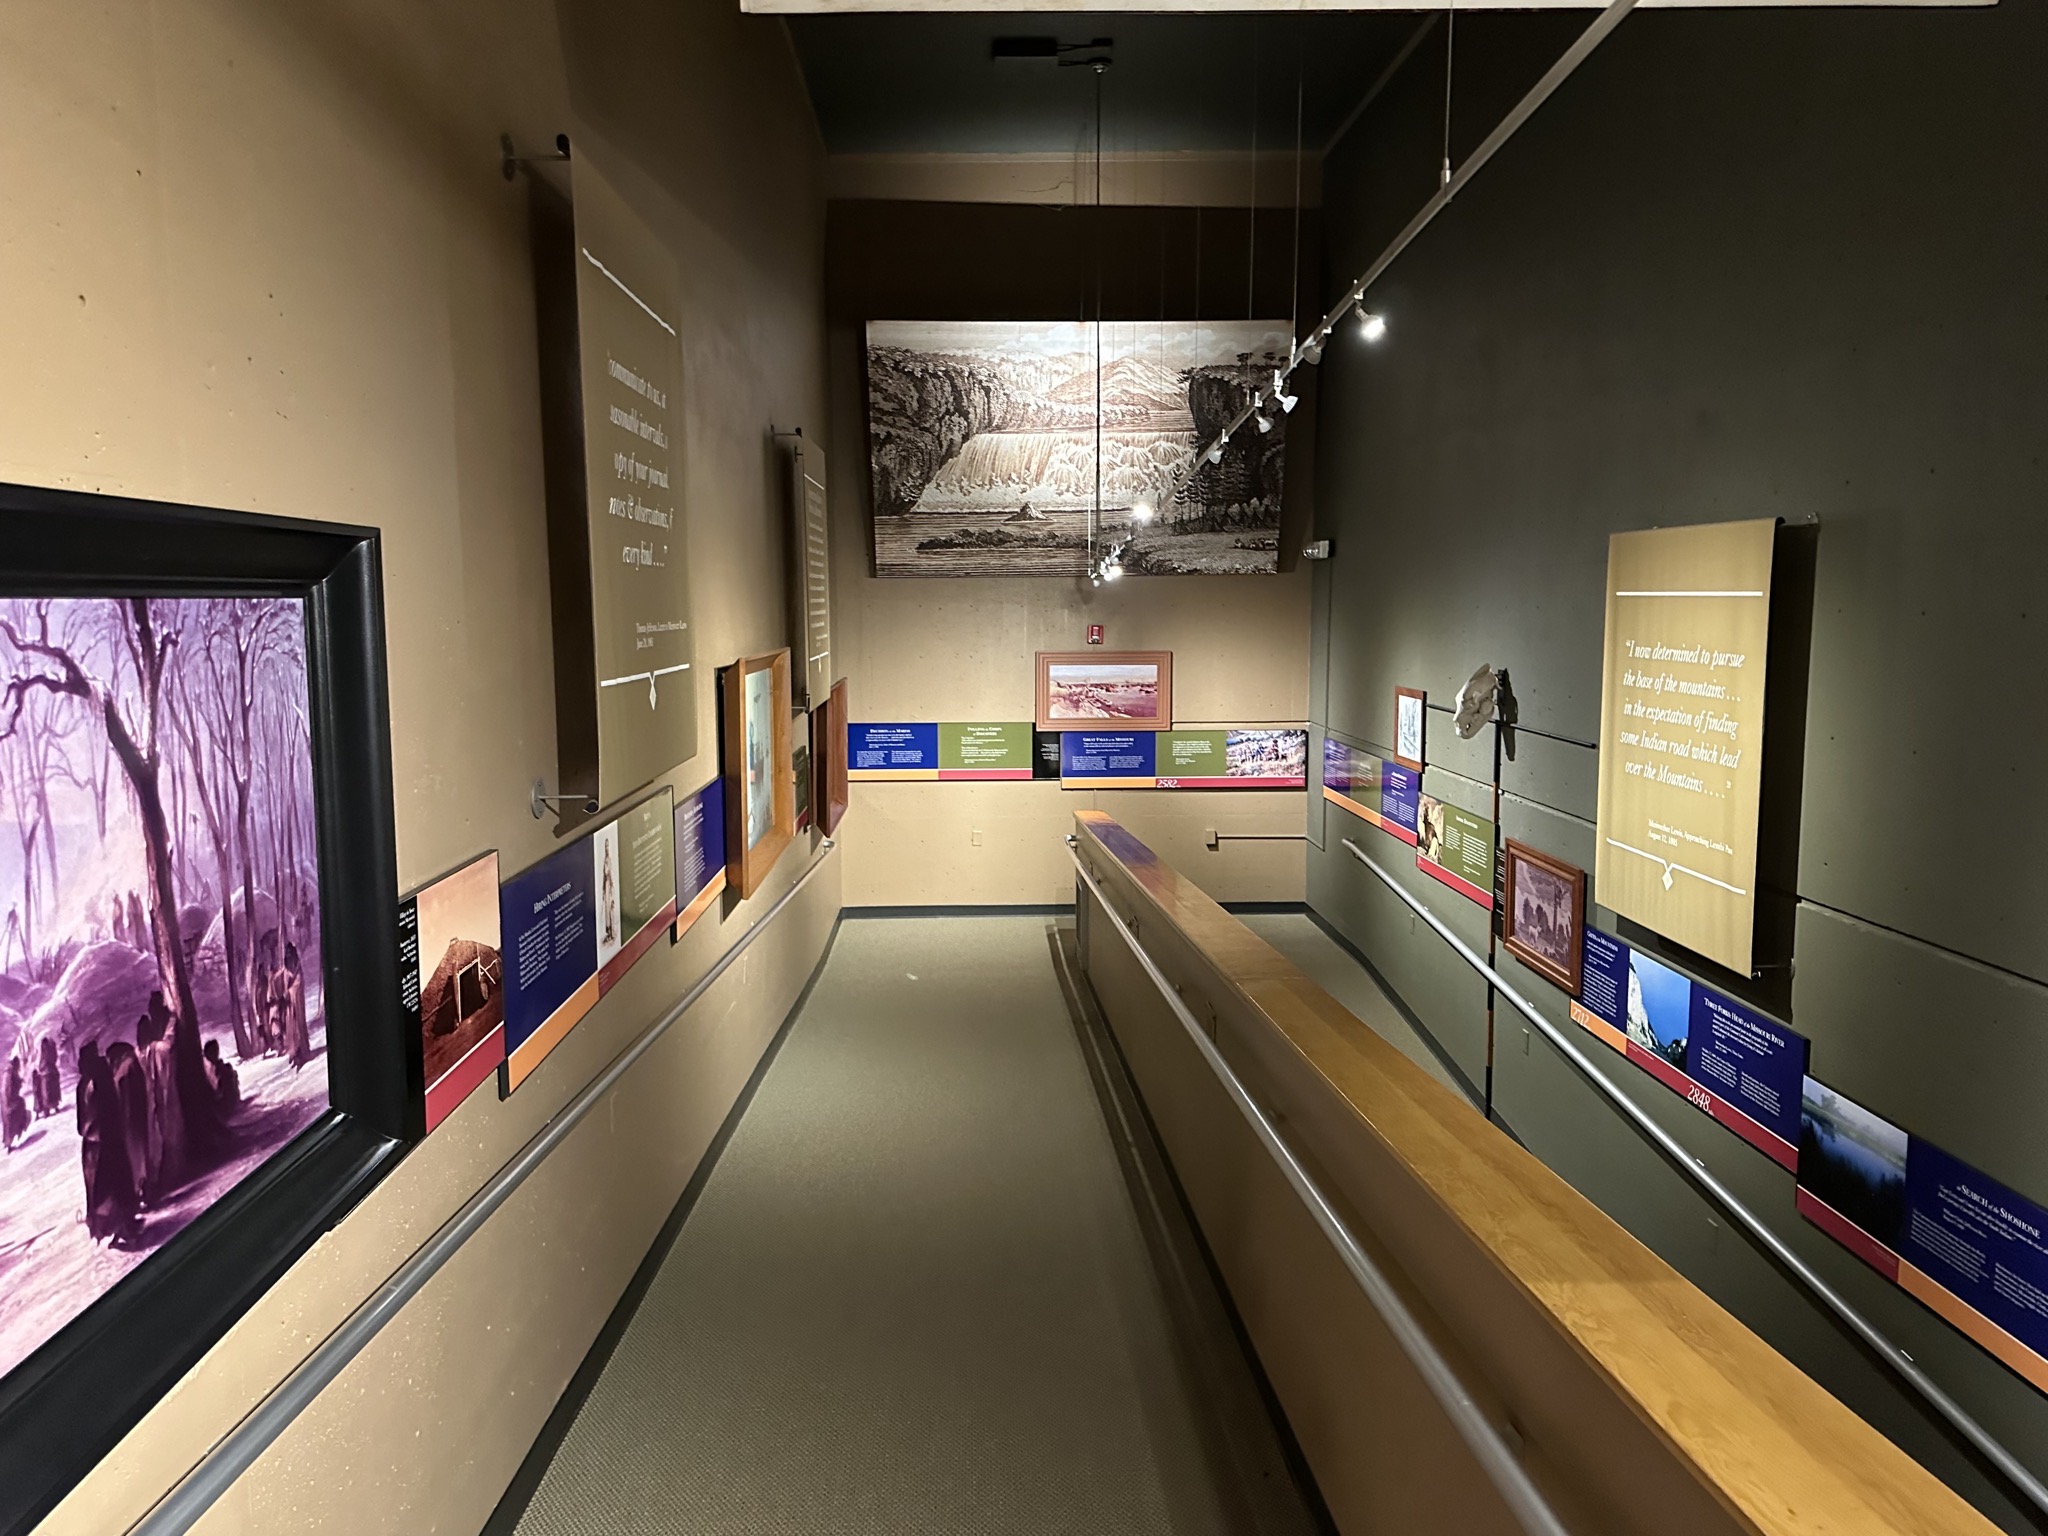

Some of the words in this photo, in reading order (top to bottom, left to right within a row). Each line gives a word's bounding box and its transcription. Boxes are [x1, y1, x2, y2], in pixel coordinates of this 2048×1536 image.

[1635, 645, 1651, 659] now
[1652, 642, 1701, 663] determined
[1700, 647, 1711, 665] to
[1710, 650, 1745, 670] pursue
[1623, 669, 1635, 686] the
[1636, 670, 1653, 689] base
[1654, 673, 1666, 695] of
[1665, 674, 1678, 693] the
[1624, 698, 1633, 715] in
[1632, 700, 1645, 717] the
[1646, 706, 1693, 727] expectation
[1693, 710, 1706, 733] of
[1702, 711, 1739, 740] finding
[1619, 731, 1639, 746] some
[1640, 730, 1668, 752] Indian
[1668, 739, 1692, 758] road
[1691, 742, 1719, 764] which
[1719, 746, 1741, 769] lead
[1157, 779, 1178, 788] 2582
[1625, 761, 1643, 776] over
[1643, 761, 1656, 780] the
[1687, 1084, 1711, 1112] 2848
[1961, 1185, 1988, 1207] SEARCH
